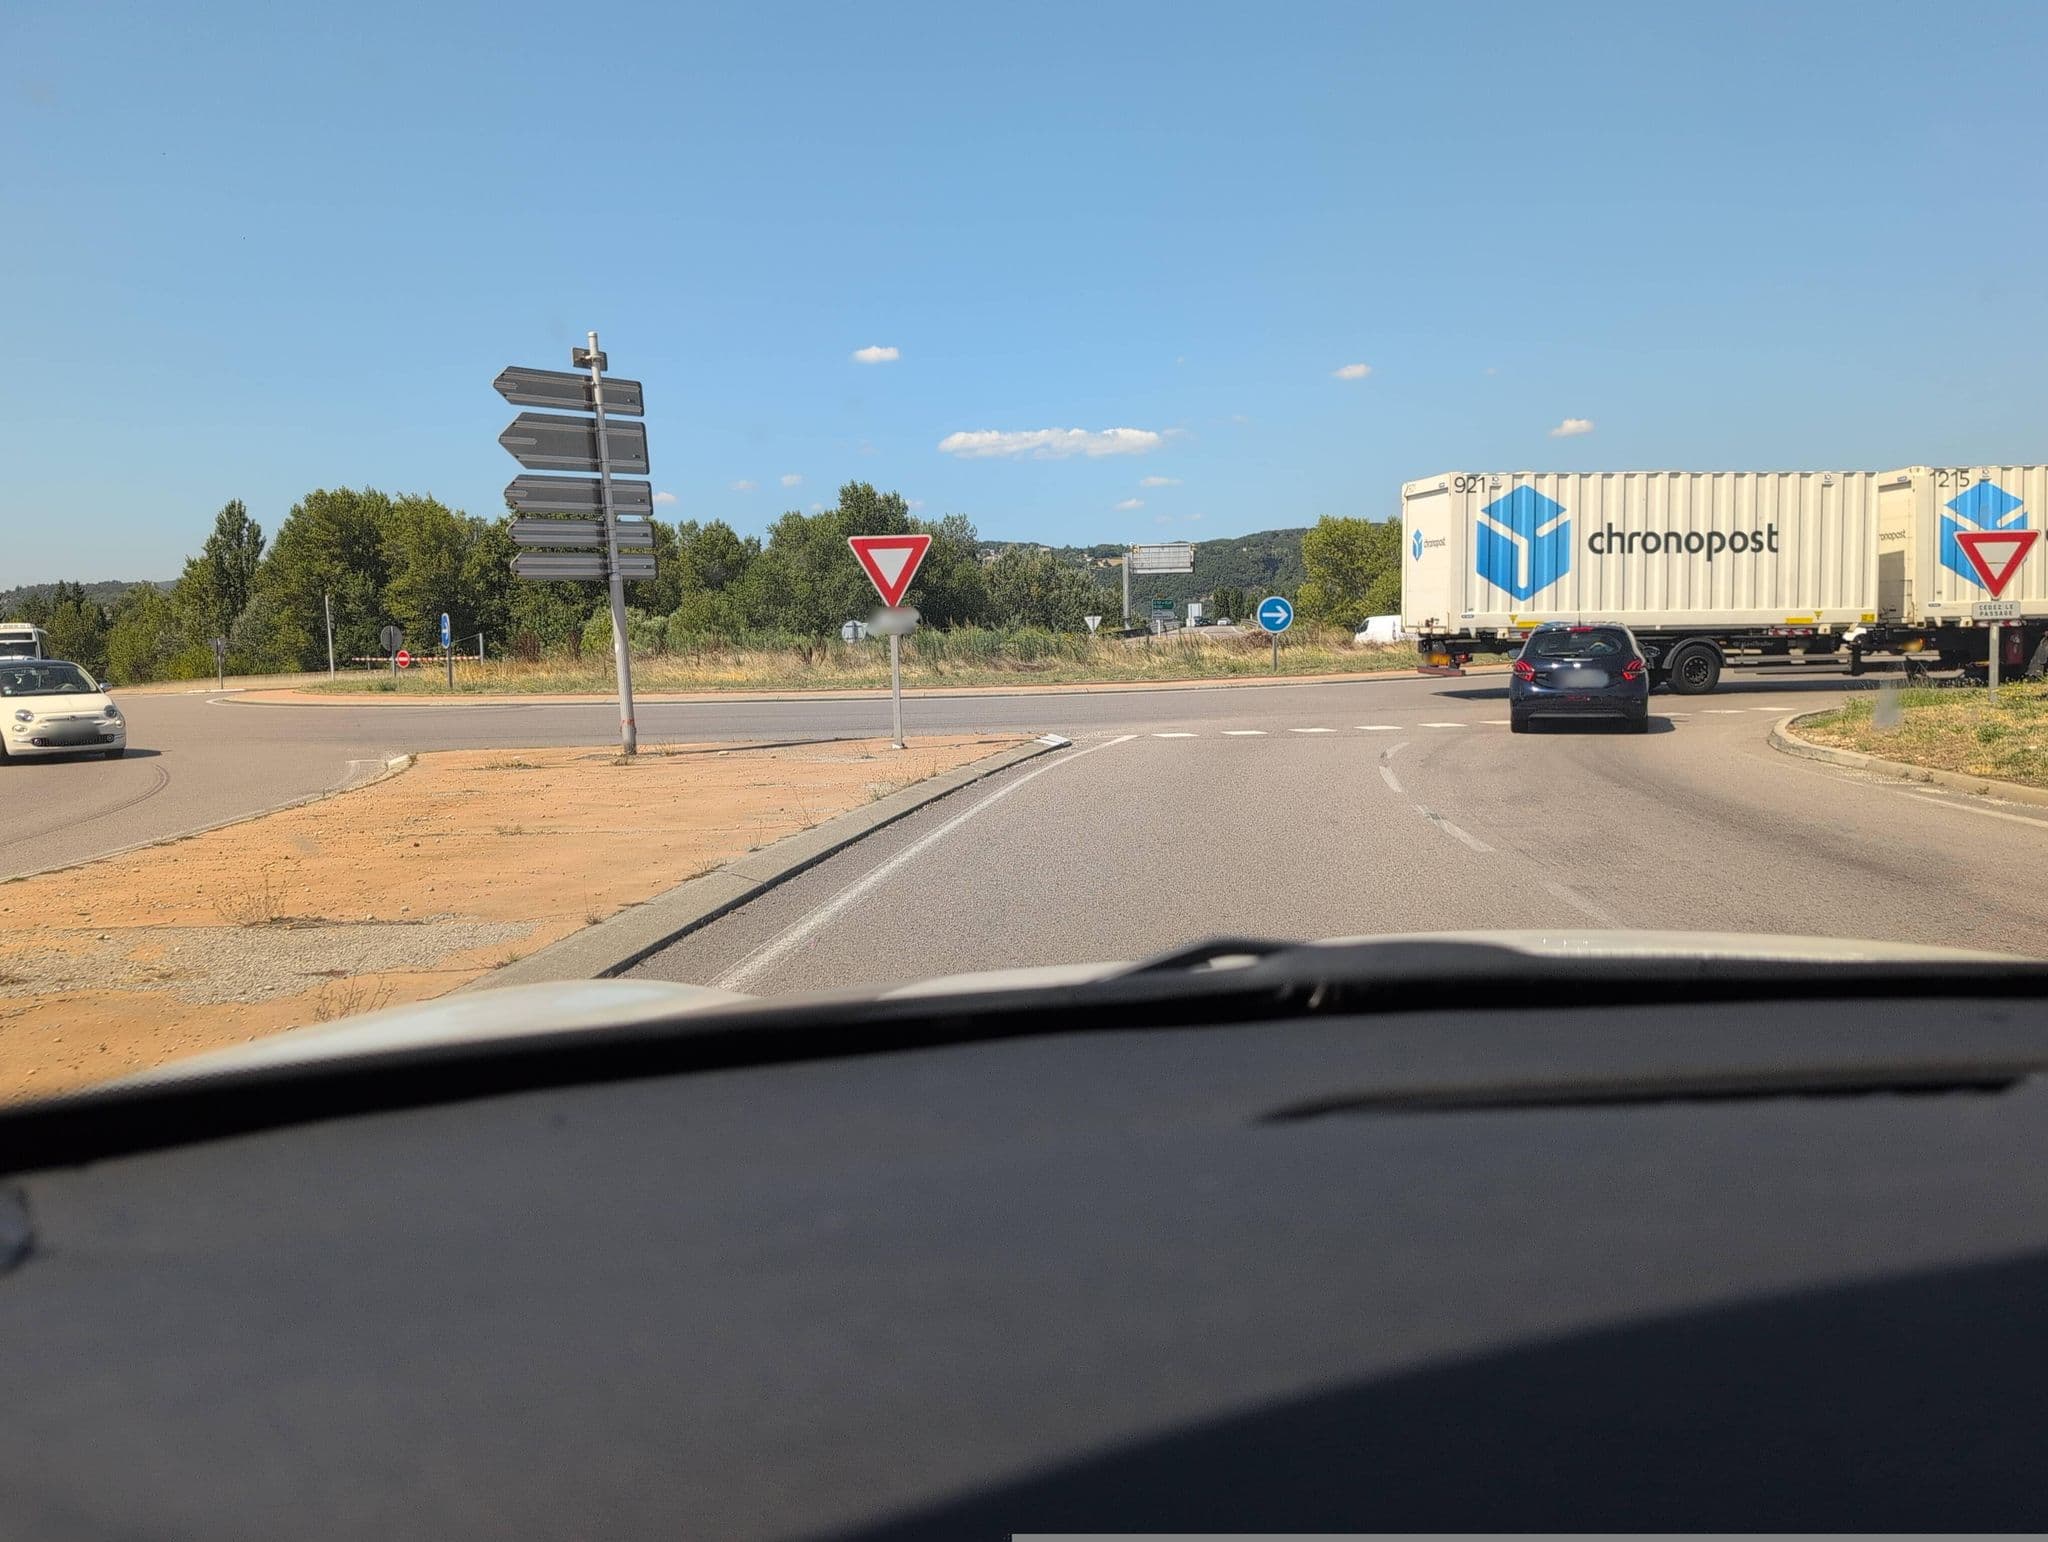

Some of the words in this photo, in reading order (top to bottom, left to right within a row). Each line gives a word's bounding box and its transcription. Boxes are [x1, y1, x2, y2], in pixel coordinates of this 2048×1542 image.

[1454, 476, 1486, 494] 921
[1929, 470, 1970, 488] 1215
[1588, 522, 1778, 562] chronopost
